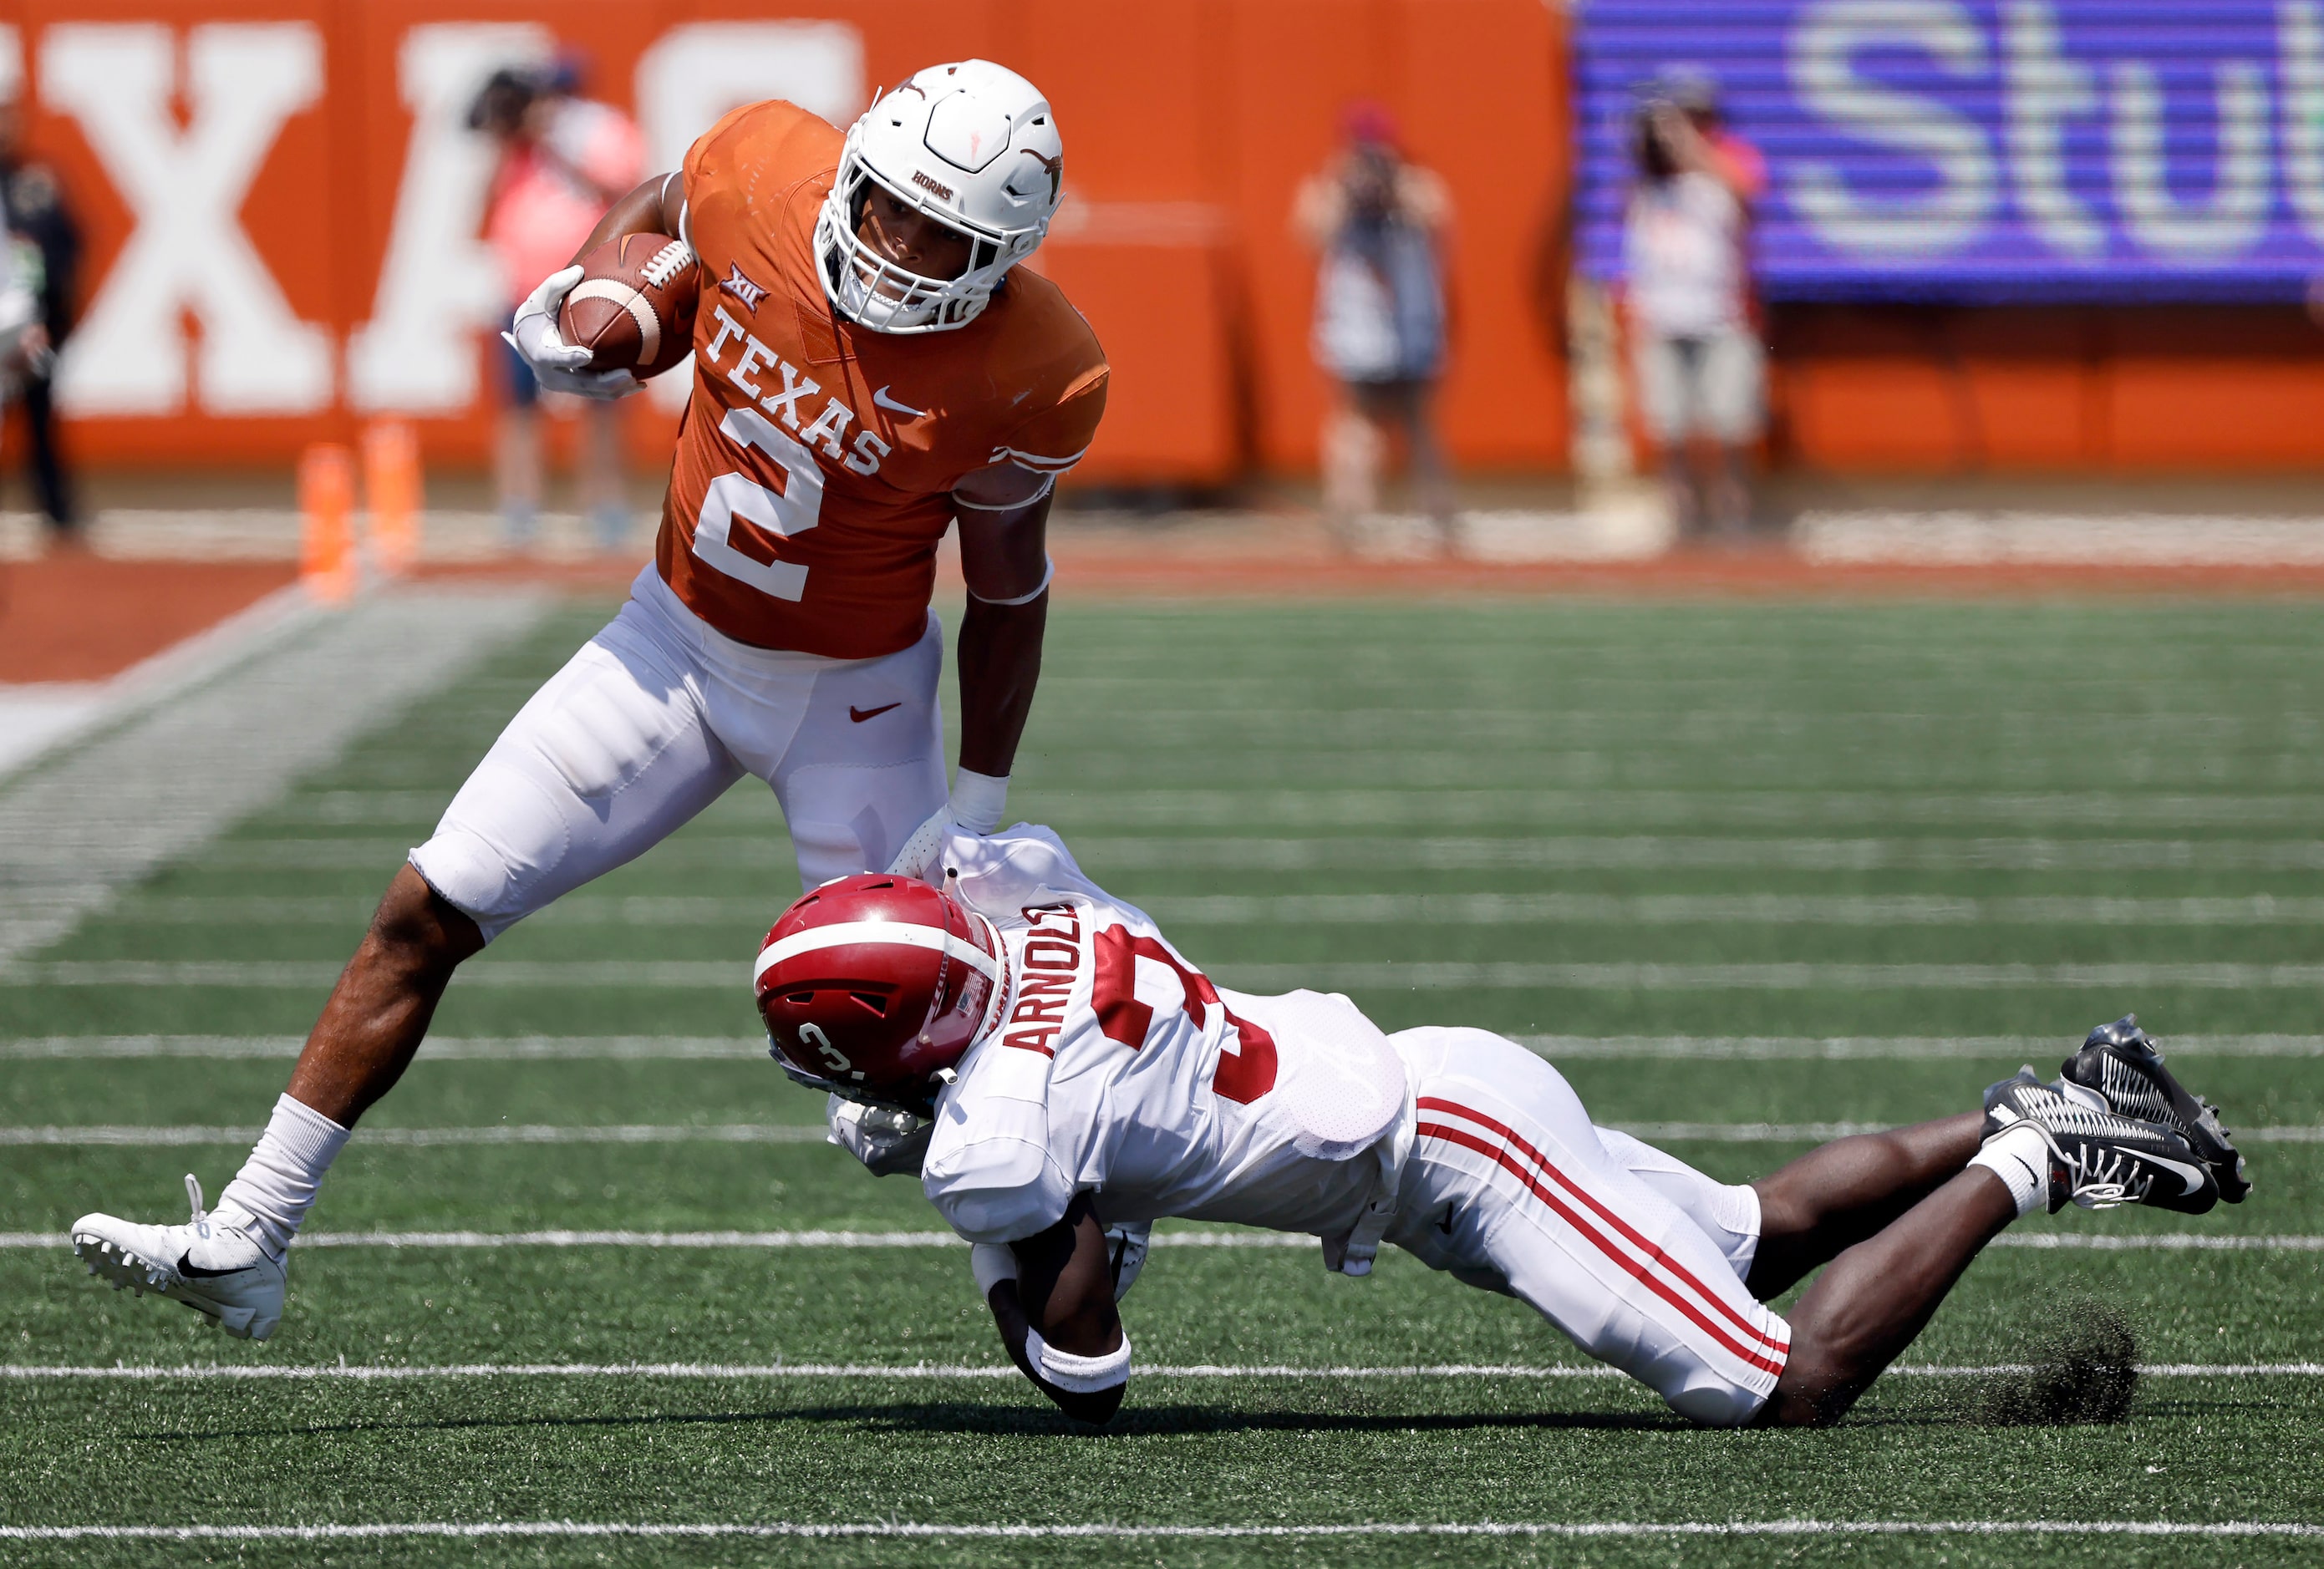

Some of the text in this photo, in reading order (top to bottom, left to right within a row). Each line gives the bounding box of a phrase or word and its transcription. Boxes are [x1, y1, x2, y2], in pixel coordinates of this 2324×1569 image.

[912, 170, 954, 201] HORNS
[706, 304, 892, 476] TEXAS
[692, 407, 826, 602] 2
[1090, 923, 1279, 1105] 3
